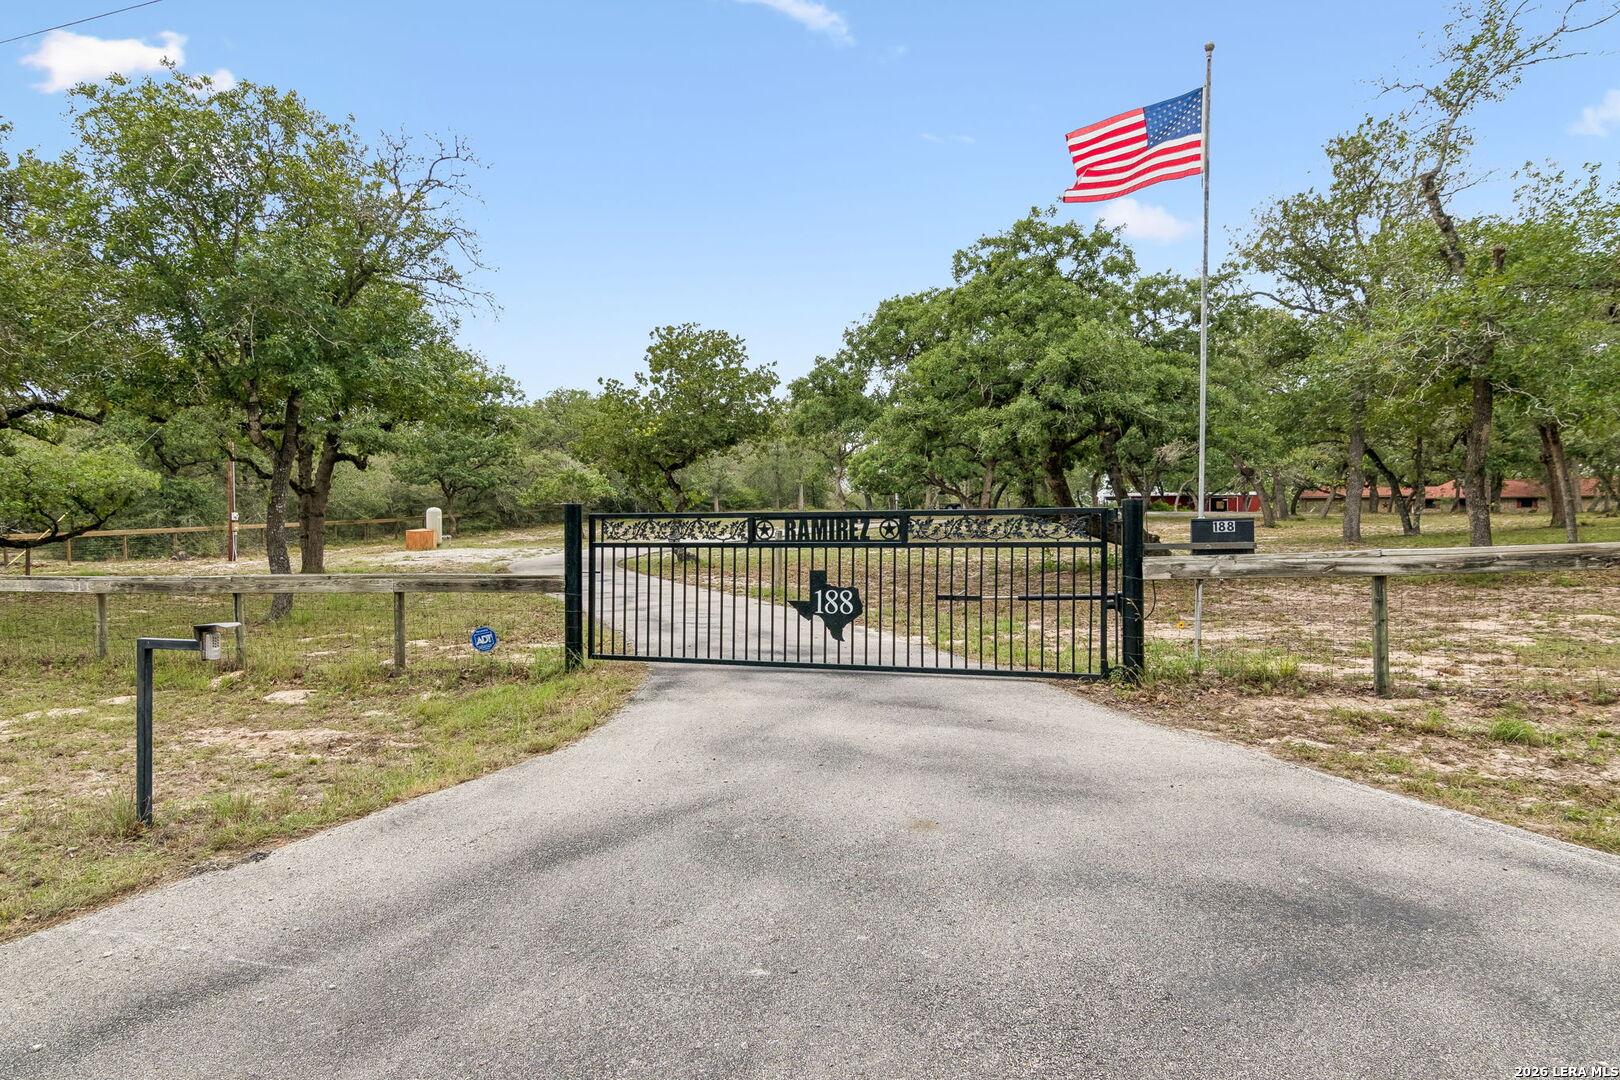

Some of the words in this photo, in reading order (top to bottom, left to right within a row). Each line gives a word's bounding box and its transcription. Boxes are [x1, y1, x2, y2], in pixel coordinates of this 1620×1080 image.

[785, 519, 870, 540] RAMIREZ
[1213, 521, 1234, 532] 188
[814, 589, 854, 615] 188
[475, 634, 492, 646] ADT
